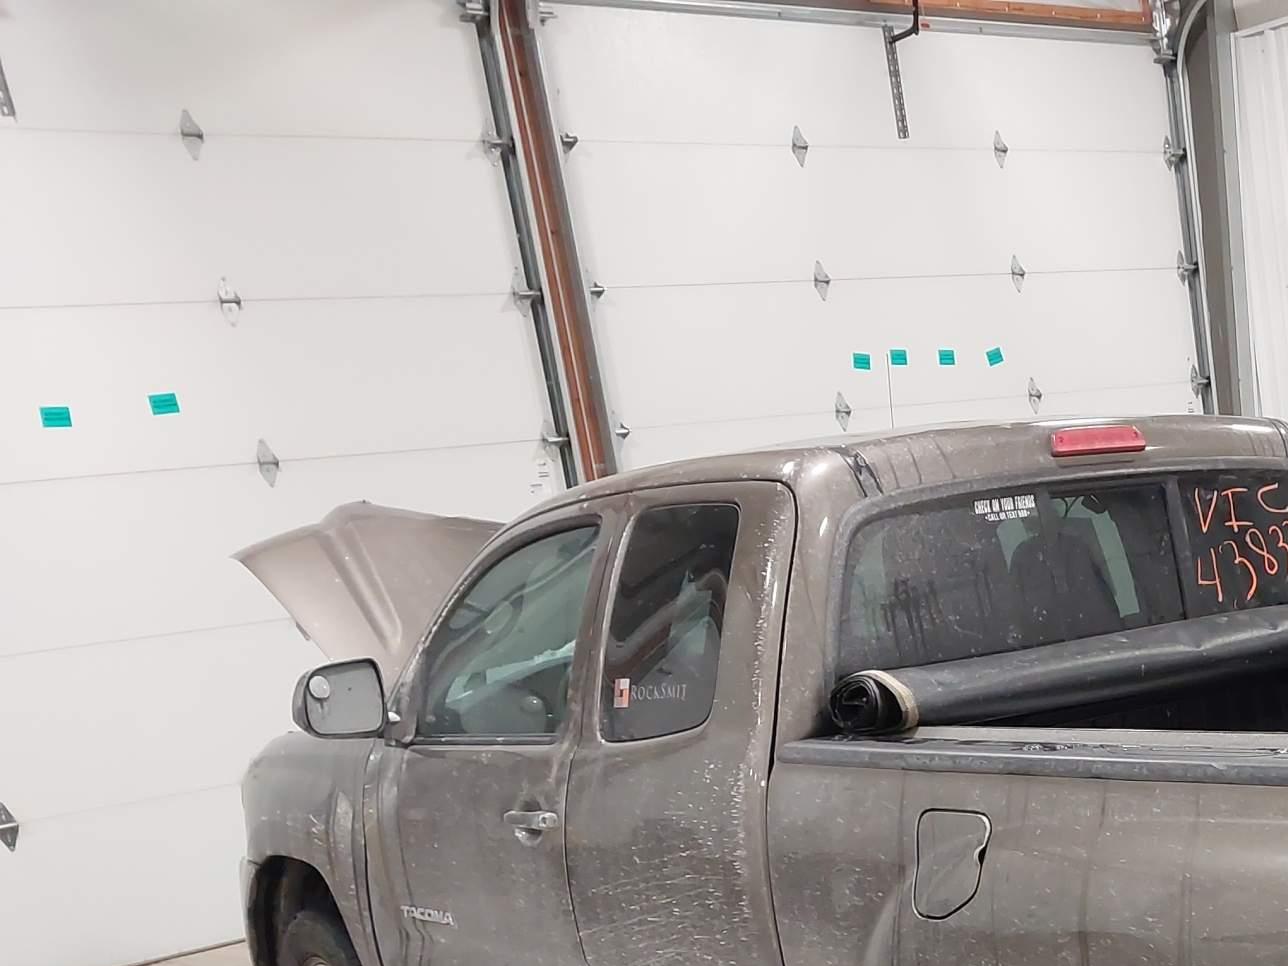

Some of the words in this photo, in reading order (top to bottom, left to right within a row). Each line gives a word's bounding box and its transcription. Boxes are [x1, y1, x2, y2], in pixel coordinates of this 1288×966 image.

[1000, 497, 1014, 511] YOUR
[1014, 495, 1035, 509] FRIENDS
[400, 905, 455, 926] TACOMA
